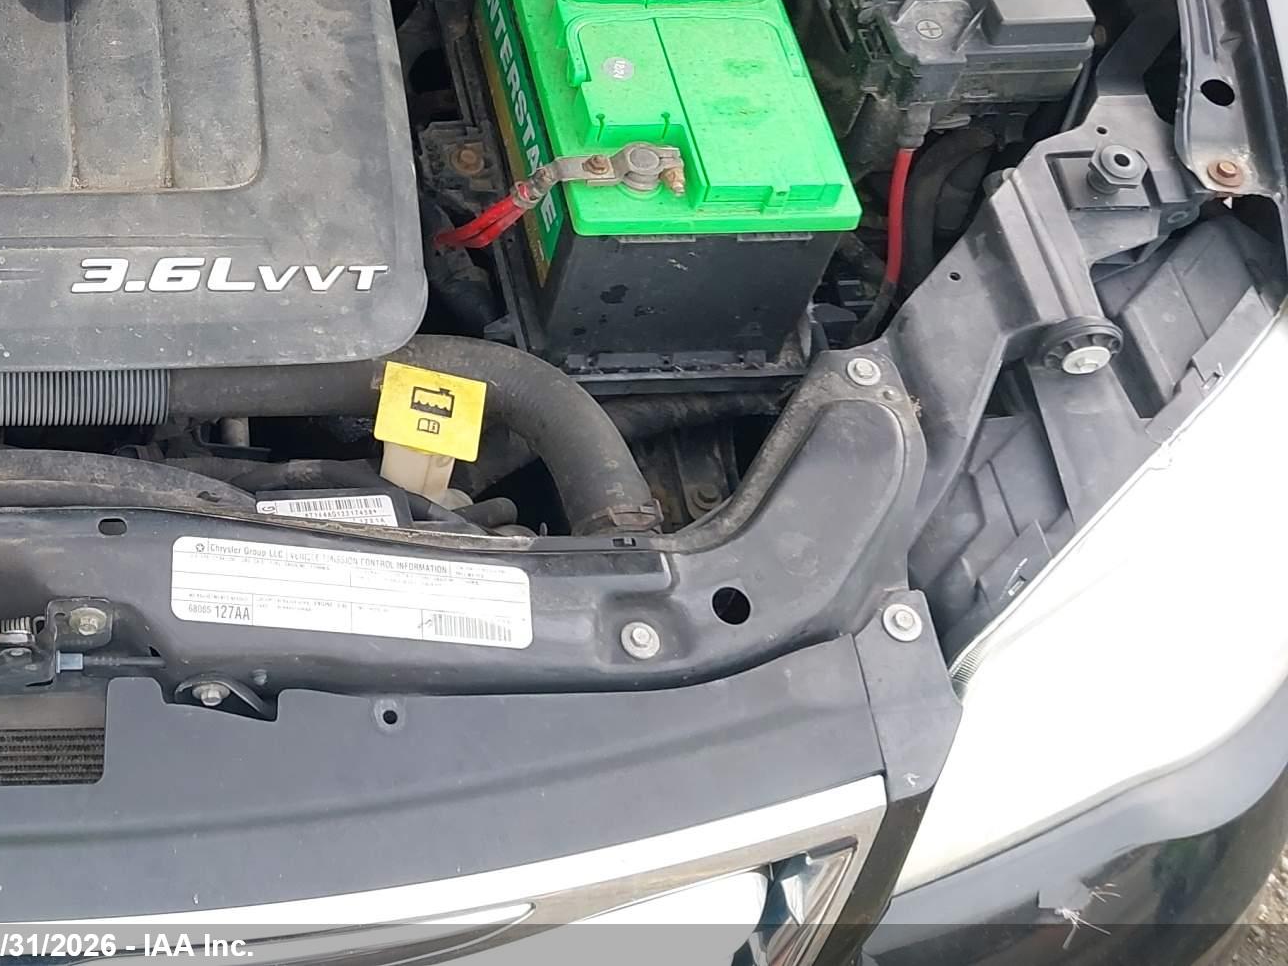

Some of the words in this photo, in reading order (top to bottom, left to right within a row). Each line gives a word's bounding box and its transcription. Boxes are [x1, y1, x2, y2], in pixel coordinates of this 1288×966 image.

[211, 543, 241, 555] Chrysler
[243, 546, 268, 558] Group
[270, 549, 283, 559] LLC
[360, 558, 395, 570] CONTROL
[396, 561, 448, 574] INFORMATION
[214, 604, 250, 620] 127AA
